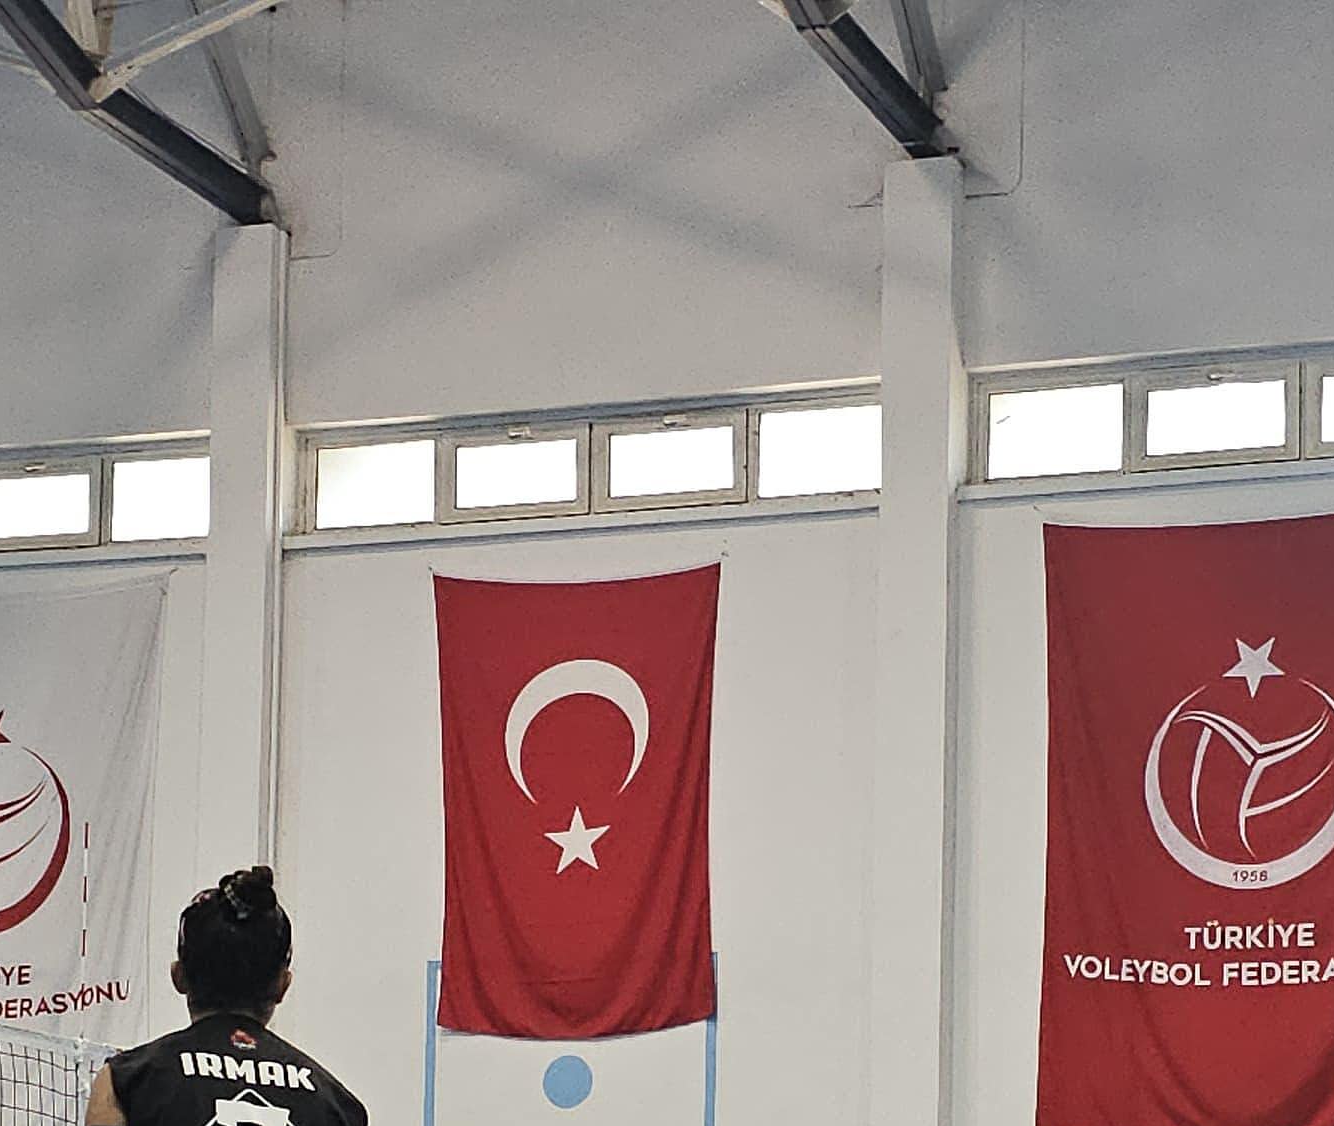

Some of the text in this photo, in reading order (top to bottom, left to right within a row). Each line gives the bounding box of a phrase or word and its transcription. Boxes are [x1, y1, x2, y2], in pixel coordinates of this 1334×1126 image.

[1232, 870, 1268, 883] 1958
[1184, 918, 1316, 950] TÜRKİYE
[1064, 954, 1211, 987] VOLEYBOL
[179, 1051, 316, 1091] IRMAK
